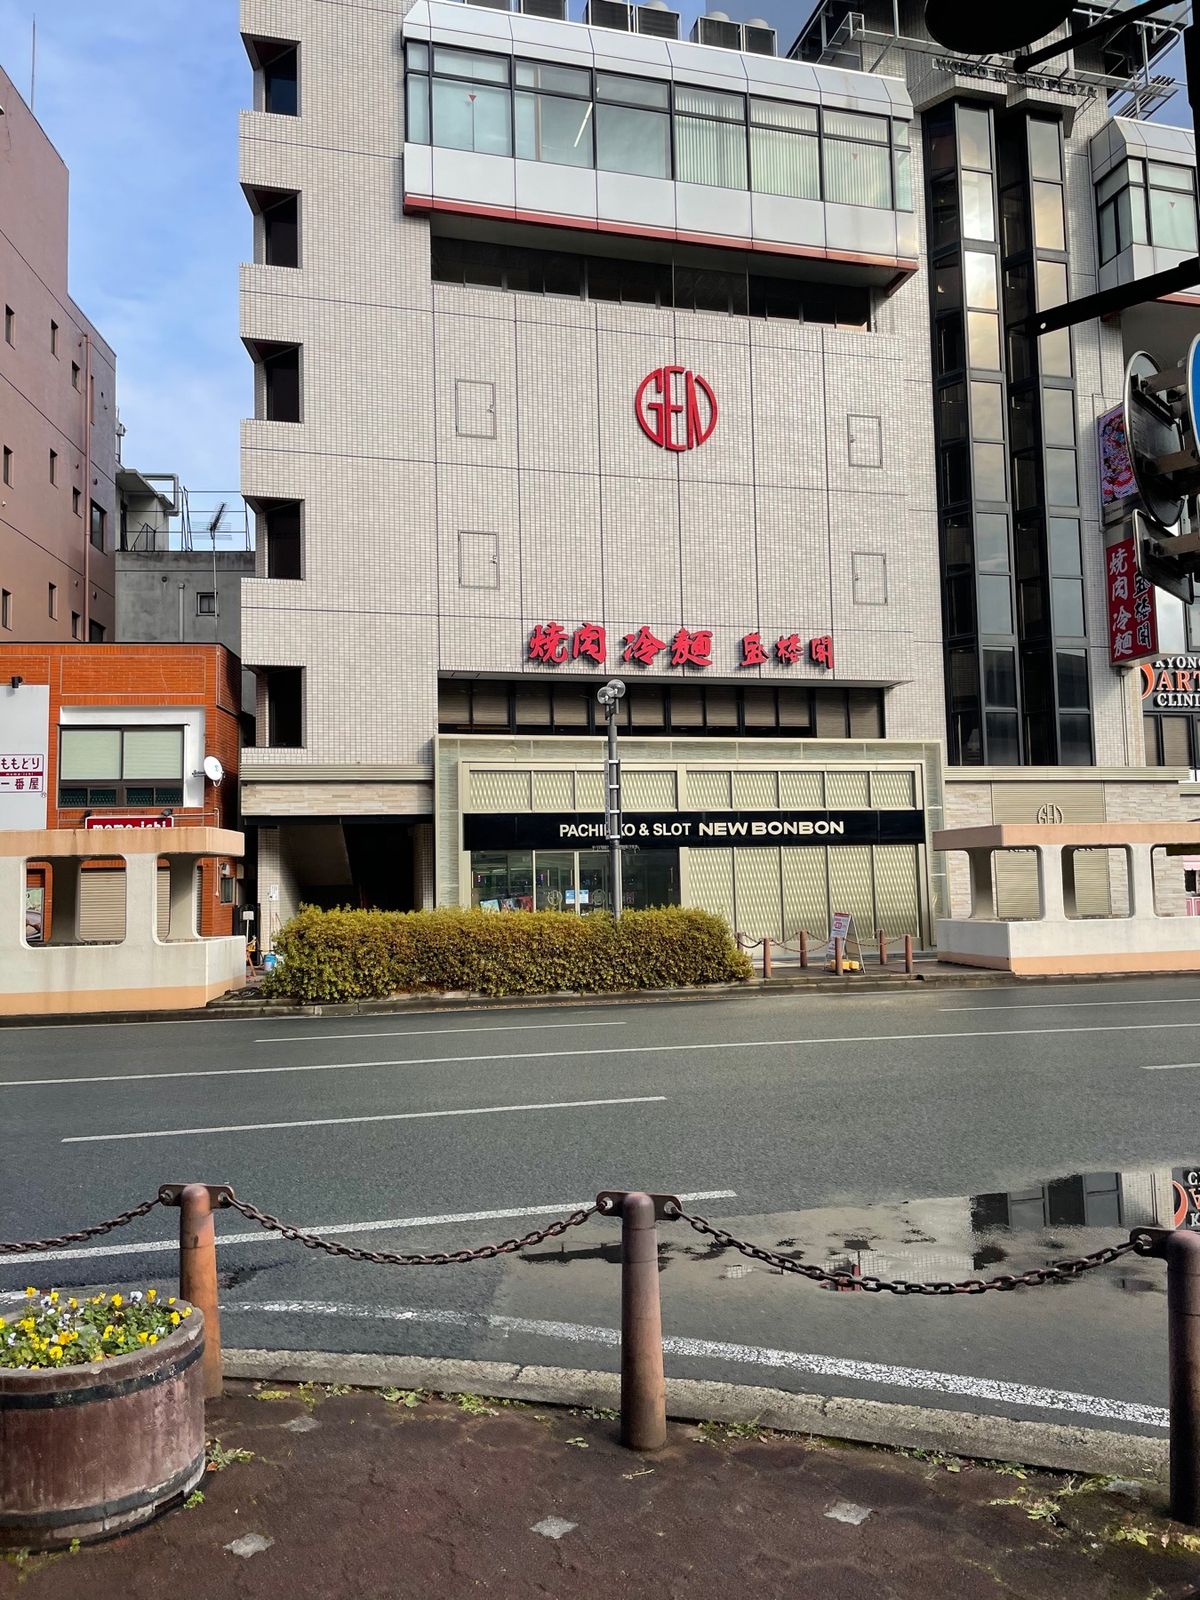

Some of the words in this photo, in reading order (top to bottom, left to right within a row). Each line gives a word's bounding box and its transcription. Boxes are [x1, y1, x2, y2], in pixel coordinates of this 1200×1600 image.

[635, 366, 718, 452] GEN
[529, 621, 606, 664] 焼肉
[1155, 656, 1200, 668] KYON
[1, 777, 40, 790] 一番屋
[559, 823, 636, 837] PACHIO
[638, 823, 650, 836] &
[652, 822, 692, 836] SLOT
[698, 822, 748, 836] NEW
[751, 821, 845, 836] BONBON
